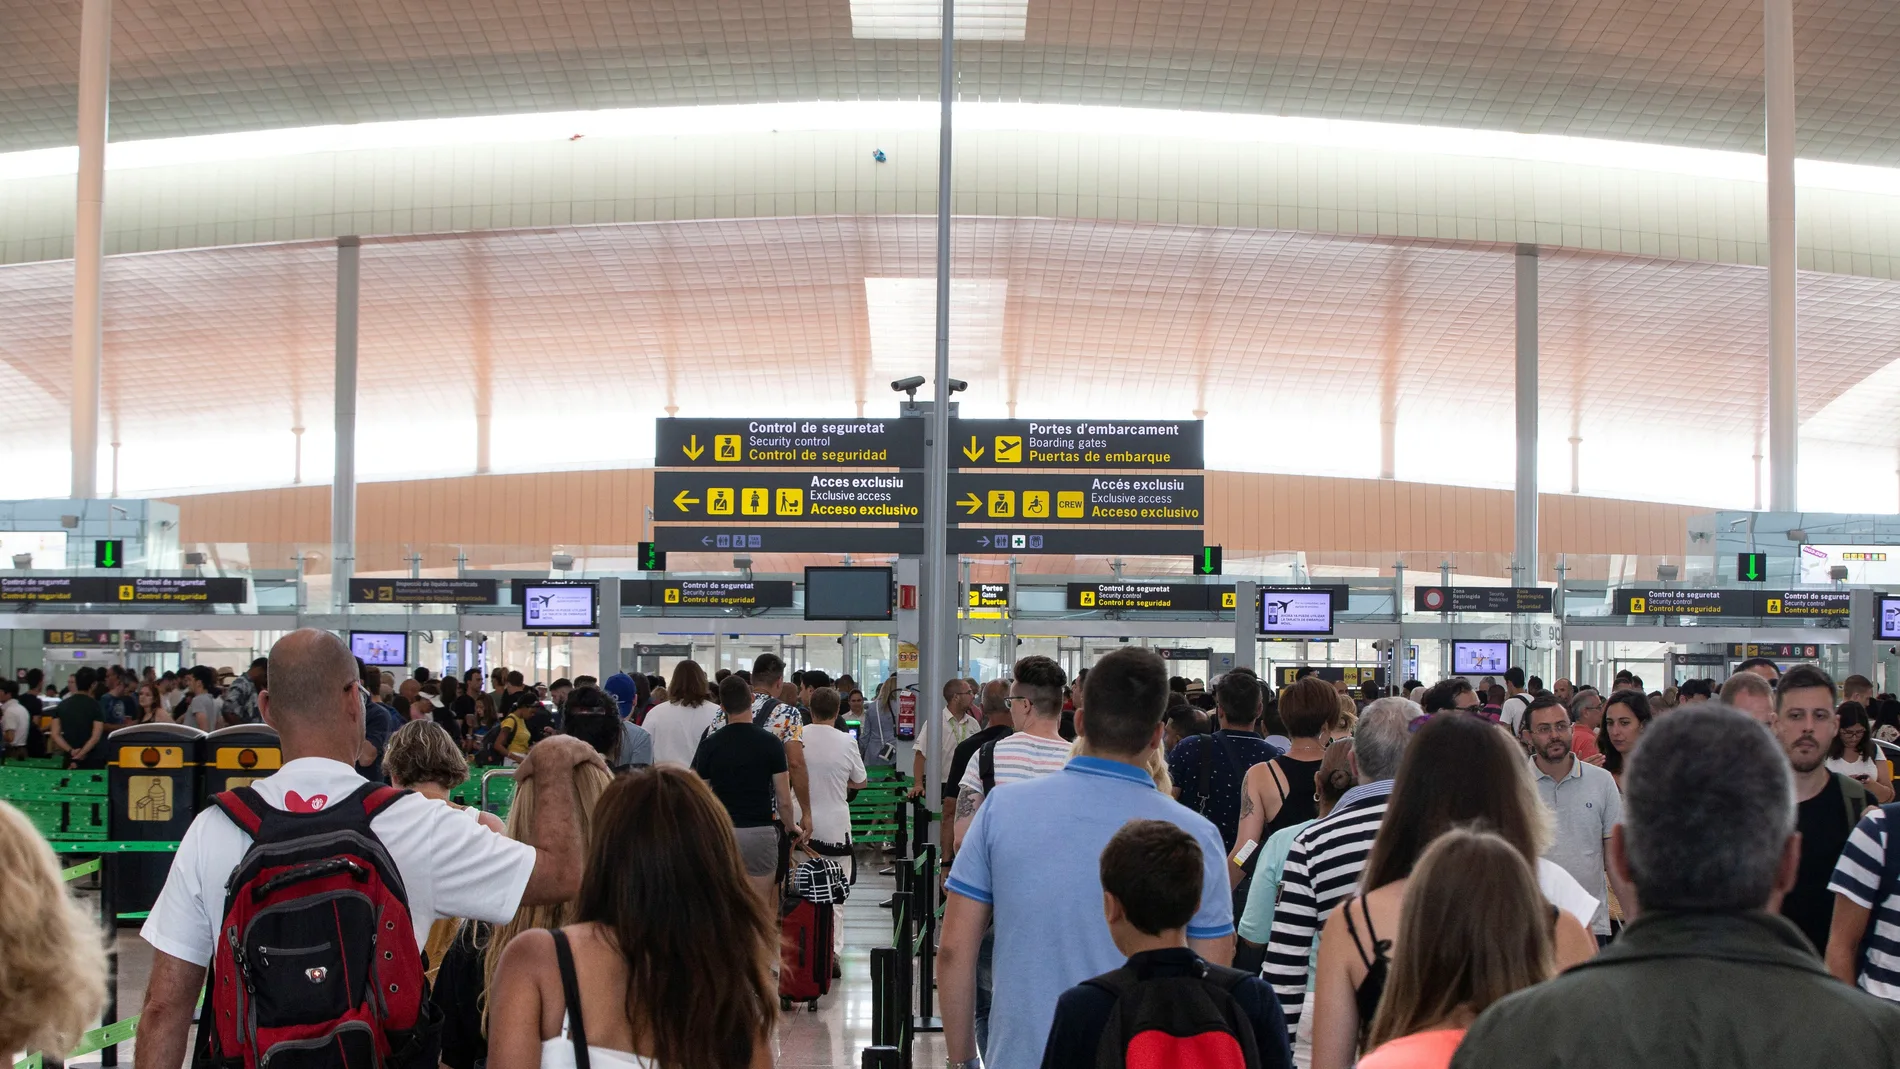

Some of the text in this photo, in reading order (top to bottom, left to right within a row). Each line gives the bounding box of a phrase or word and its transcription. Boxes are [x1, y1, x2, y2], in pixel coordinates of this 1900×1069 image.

[749, 422, 885, 435] Control de seguretat
[1029, 423, 1179, 435] Portes d'embarcament
[749, 436, 830, 448] Security control
[1029, 438, 1107, 450] Boarding gates
[749, 449, 887, 462] Control de seguridad
[1029, 451, 1171, 465] Puertas de embarque
[811, 476, 904, 488] Acces exclusiu
[1092, 478, 1185, 491] Accés exclusiu
[810, 490, 891, 501] Exclusive access
[1091, 493, 1172, 504] Exclusive access
[810, 504, 918, 516] Acceso exclusivo
[1058, 500, 1083, 509] CREW
[1092, 506, 1199, 519] Acceso exclusivo
[1821, 607, 1850, 615] segurida
[1782, 647, 1788, 655] A
[1794, 647, 1800, 655] B
[1806, 647, 1813, 655] C
